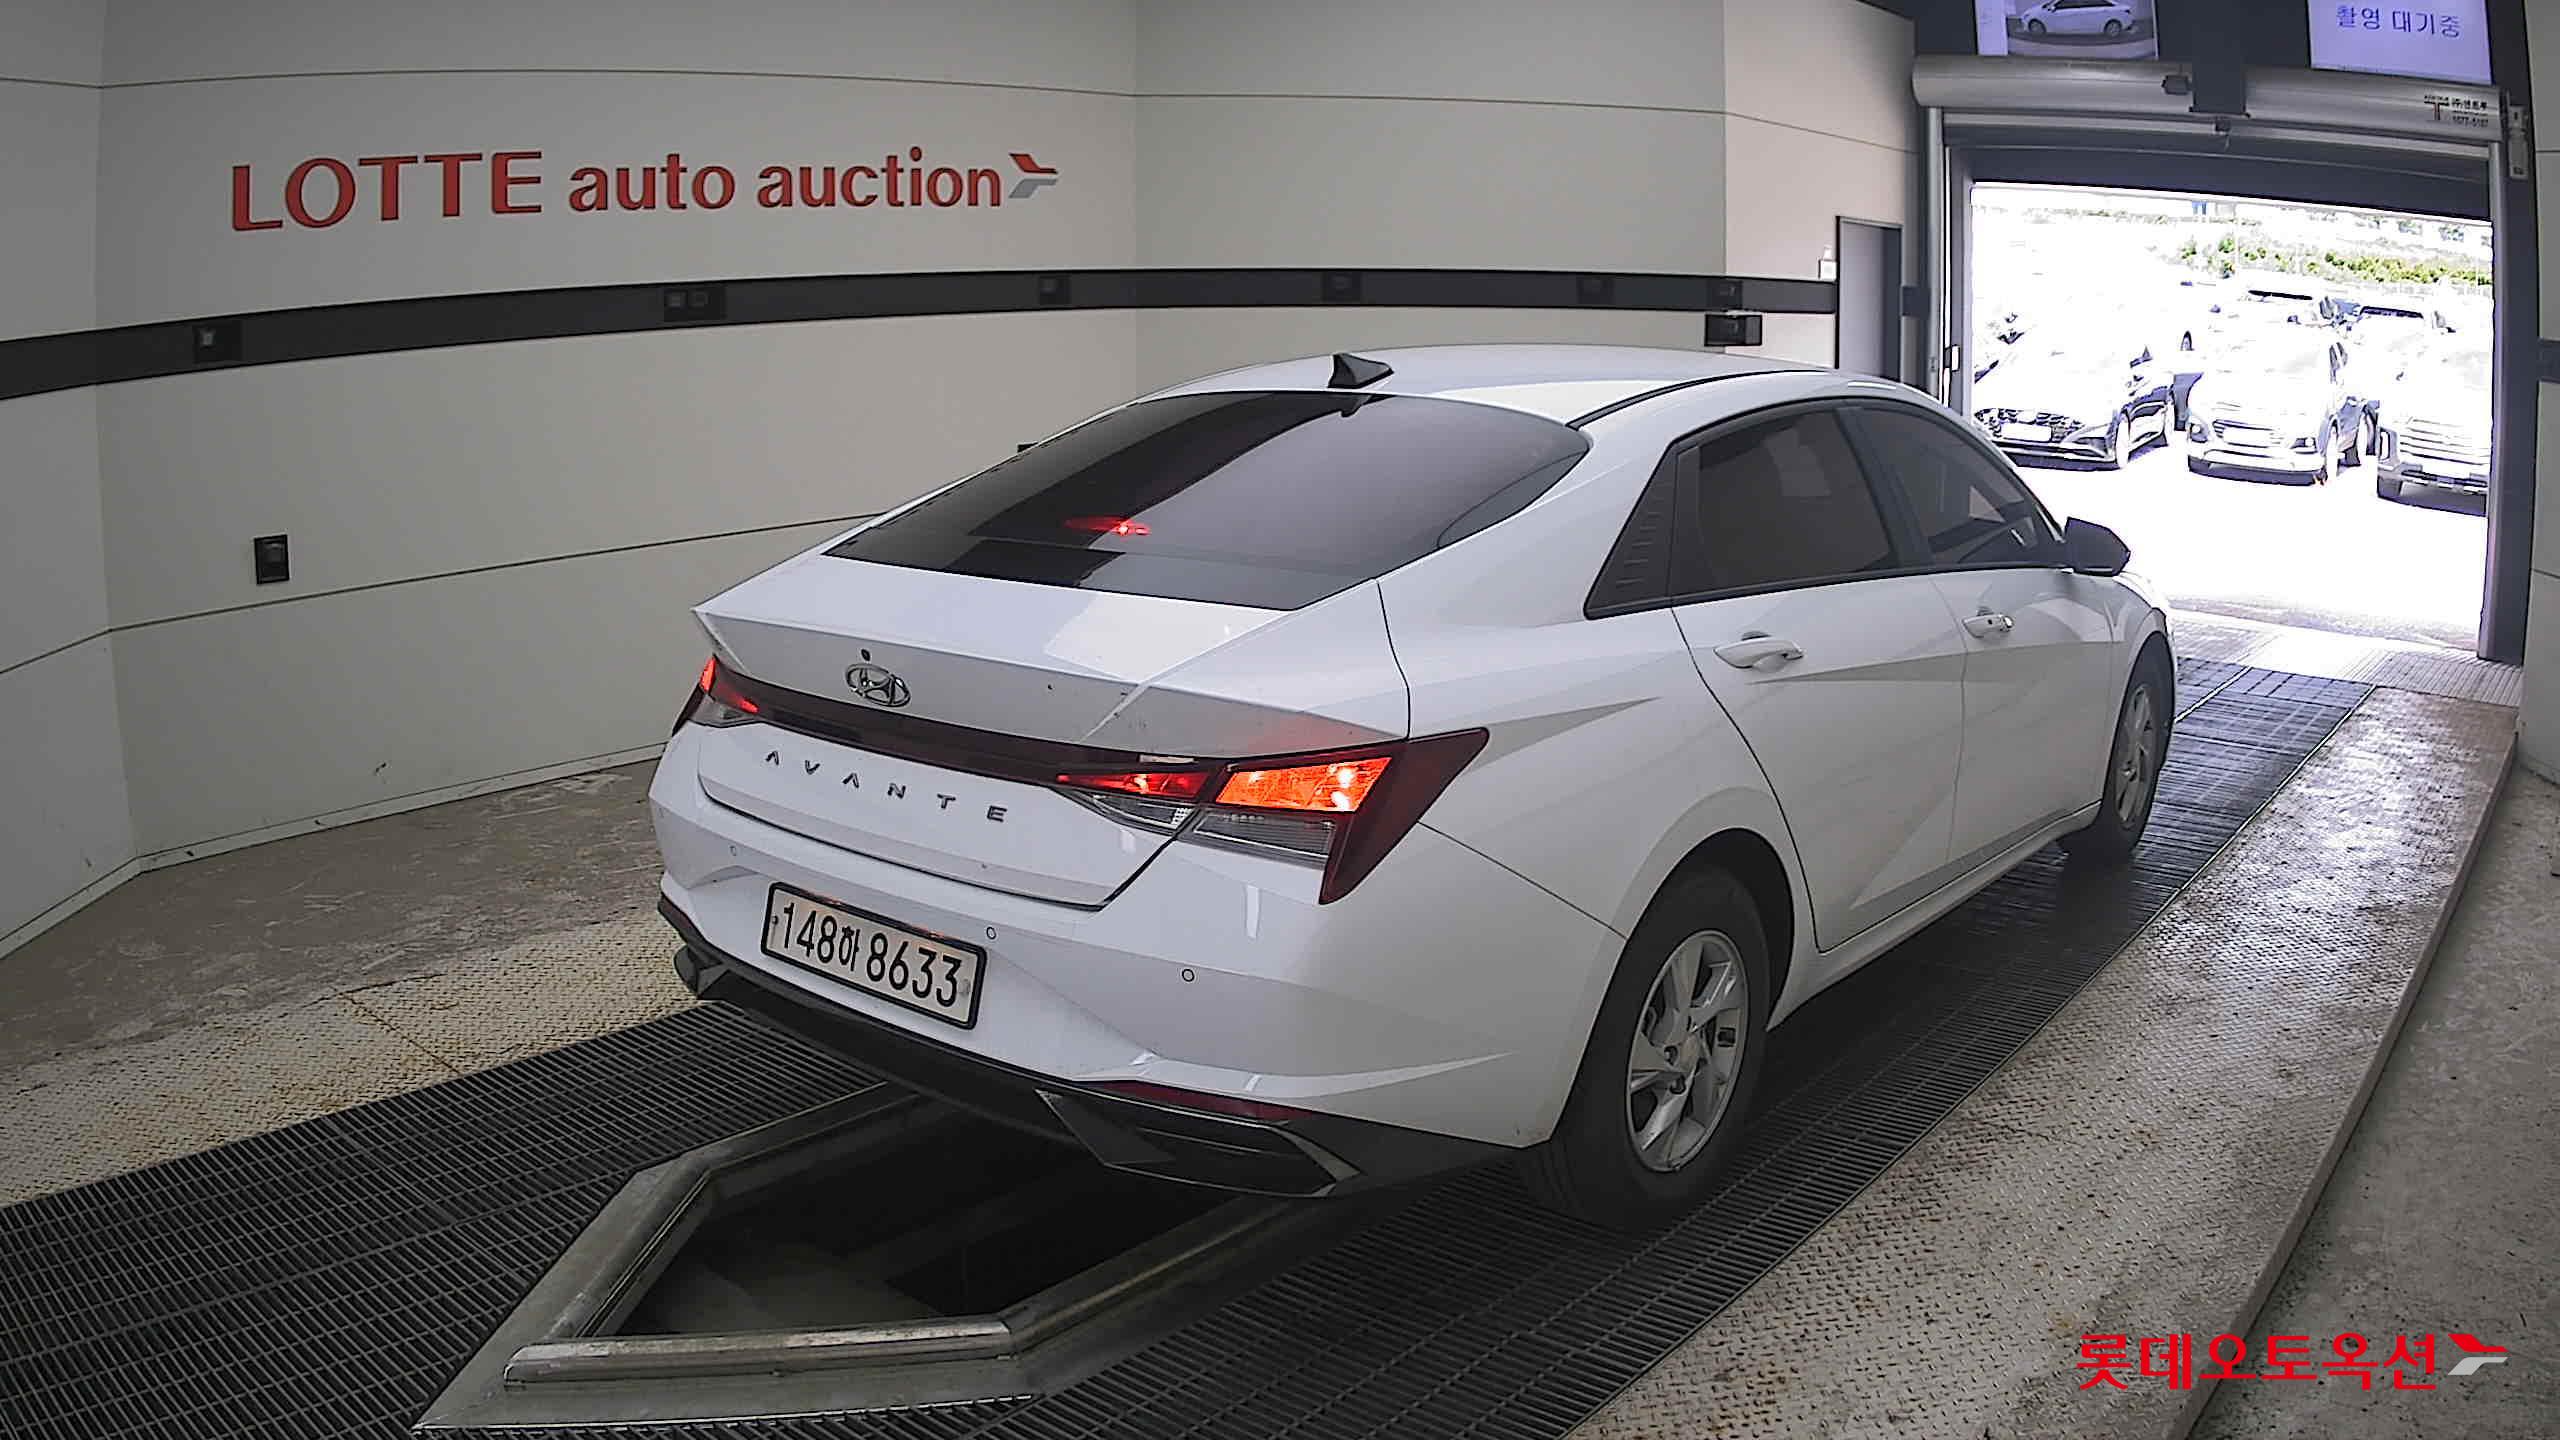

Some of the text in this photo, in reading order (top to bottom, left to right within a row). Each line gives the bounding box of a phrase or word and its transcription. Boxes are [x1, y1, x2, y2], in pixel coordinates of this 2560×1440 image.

[2336, 6, 2460, 38] 촬영 대기중
[232, 146, 1002, 231] LOTTE auto auction
[765, 750, 1008, 823] AVANTE
[783, 902, 962, 1008] 148하 8633
